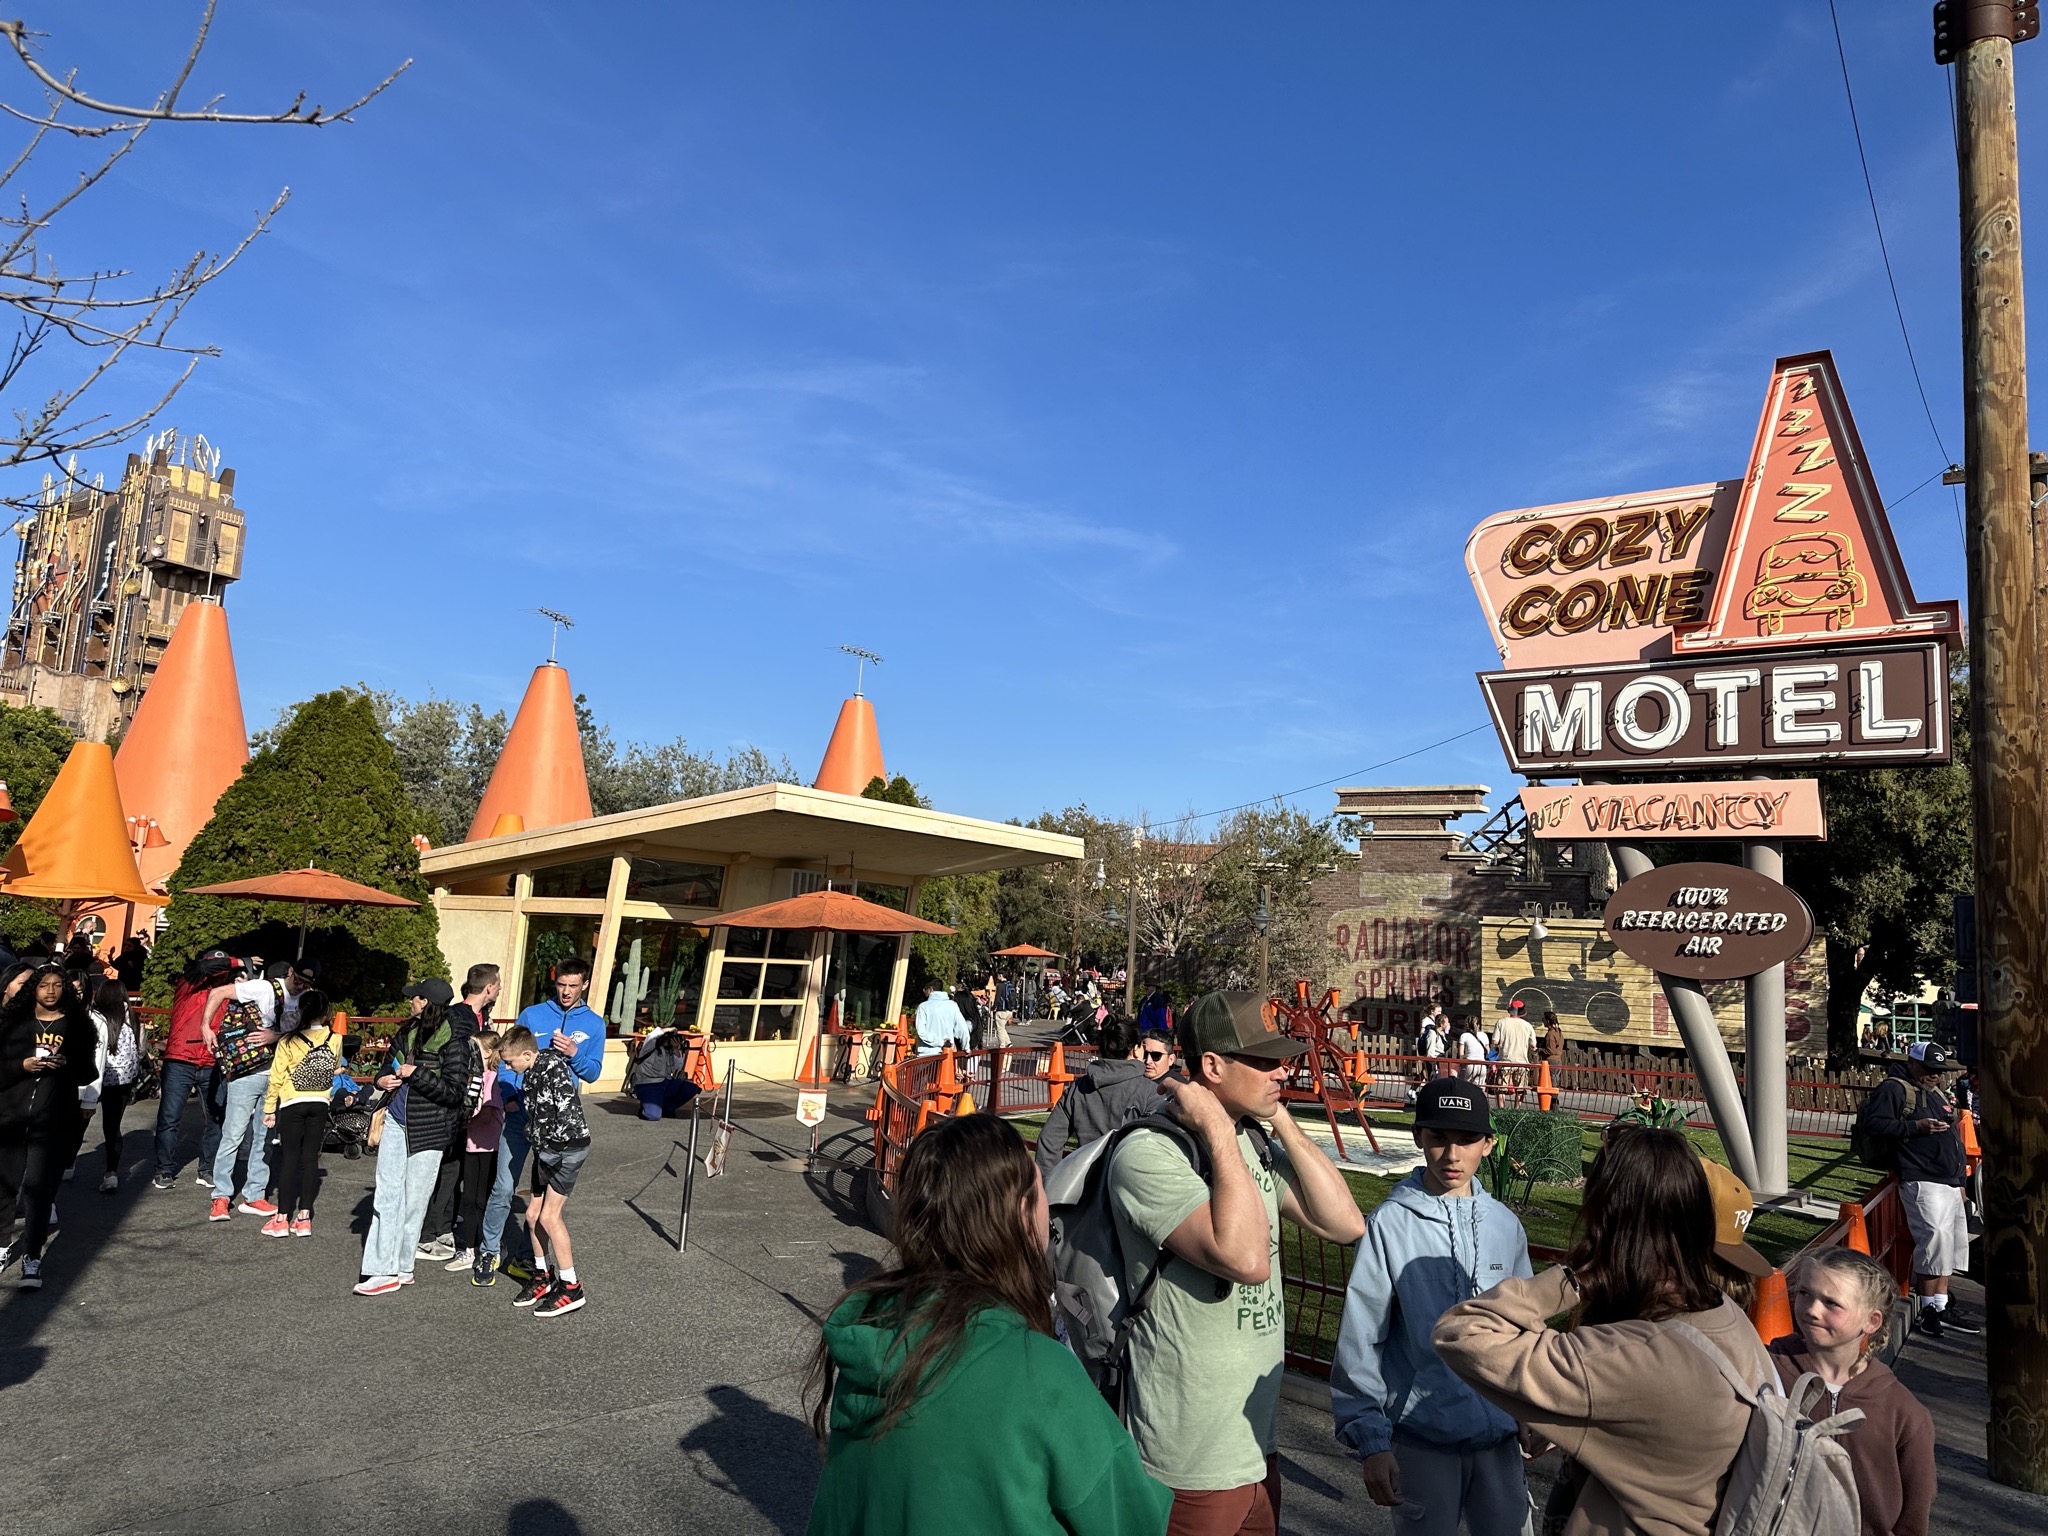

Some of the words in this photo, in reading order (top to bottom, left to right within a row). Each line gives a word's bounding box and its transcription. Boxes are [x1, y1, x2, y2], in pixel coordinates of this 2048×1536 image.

[1508, 504, 1711, 574] COZY
[1506, 567, 1709, 635] CONE
[1523, 660, 1922, 753] MOTEL
[1590, 790, 1791, 830] VACANCY
[1676, 886, 1729, 906] 100%
[1621, 909, 1788, 933] REFRIGERATED
[1336, 916, 1472, 970] RADIATOR
[1684, 935, 1723, 955] AIR
[1354, 966, 1455, 1008] SPRINGS
[1338, 1005, 1475, 1037] CURIS
[1441, 1098, 1470, 1108] VANS
[1489, 1263, 1504, 1271] VANS
[1240, 1295, 1259, 1305] the
